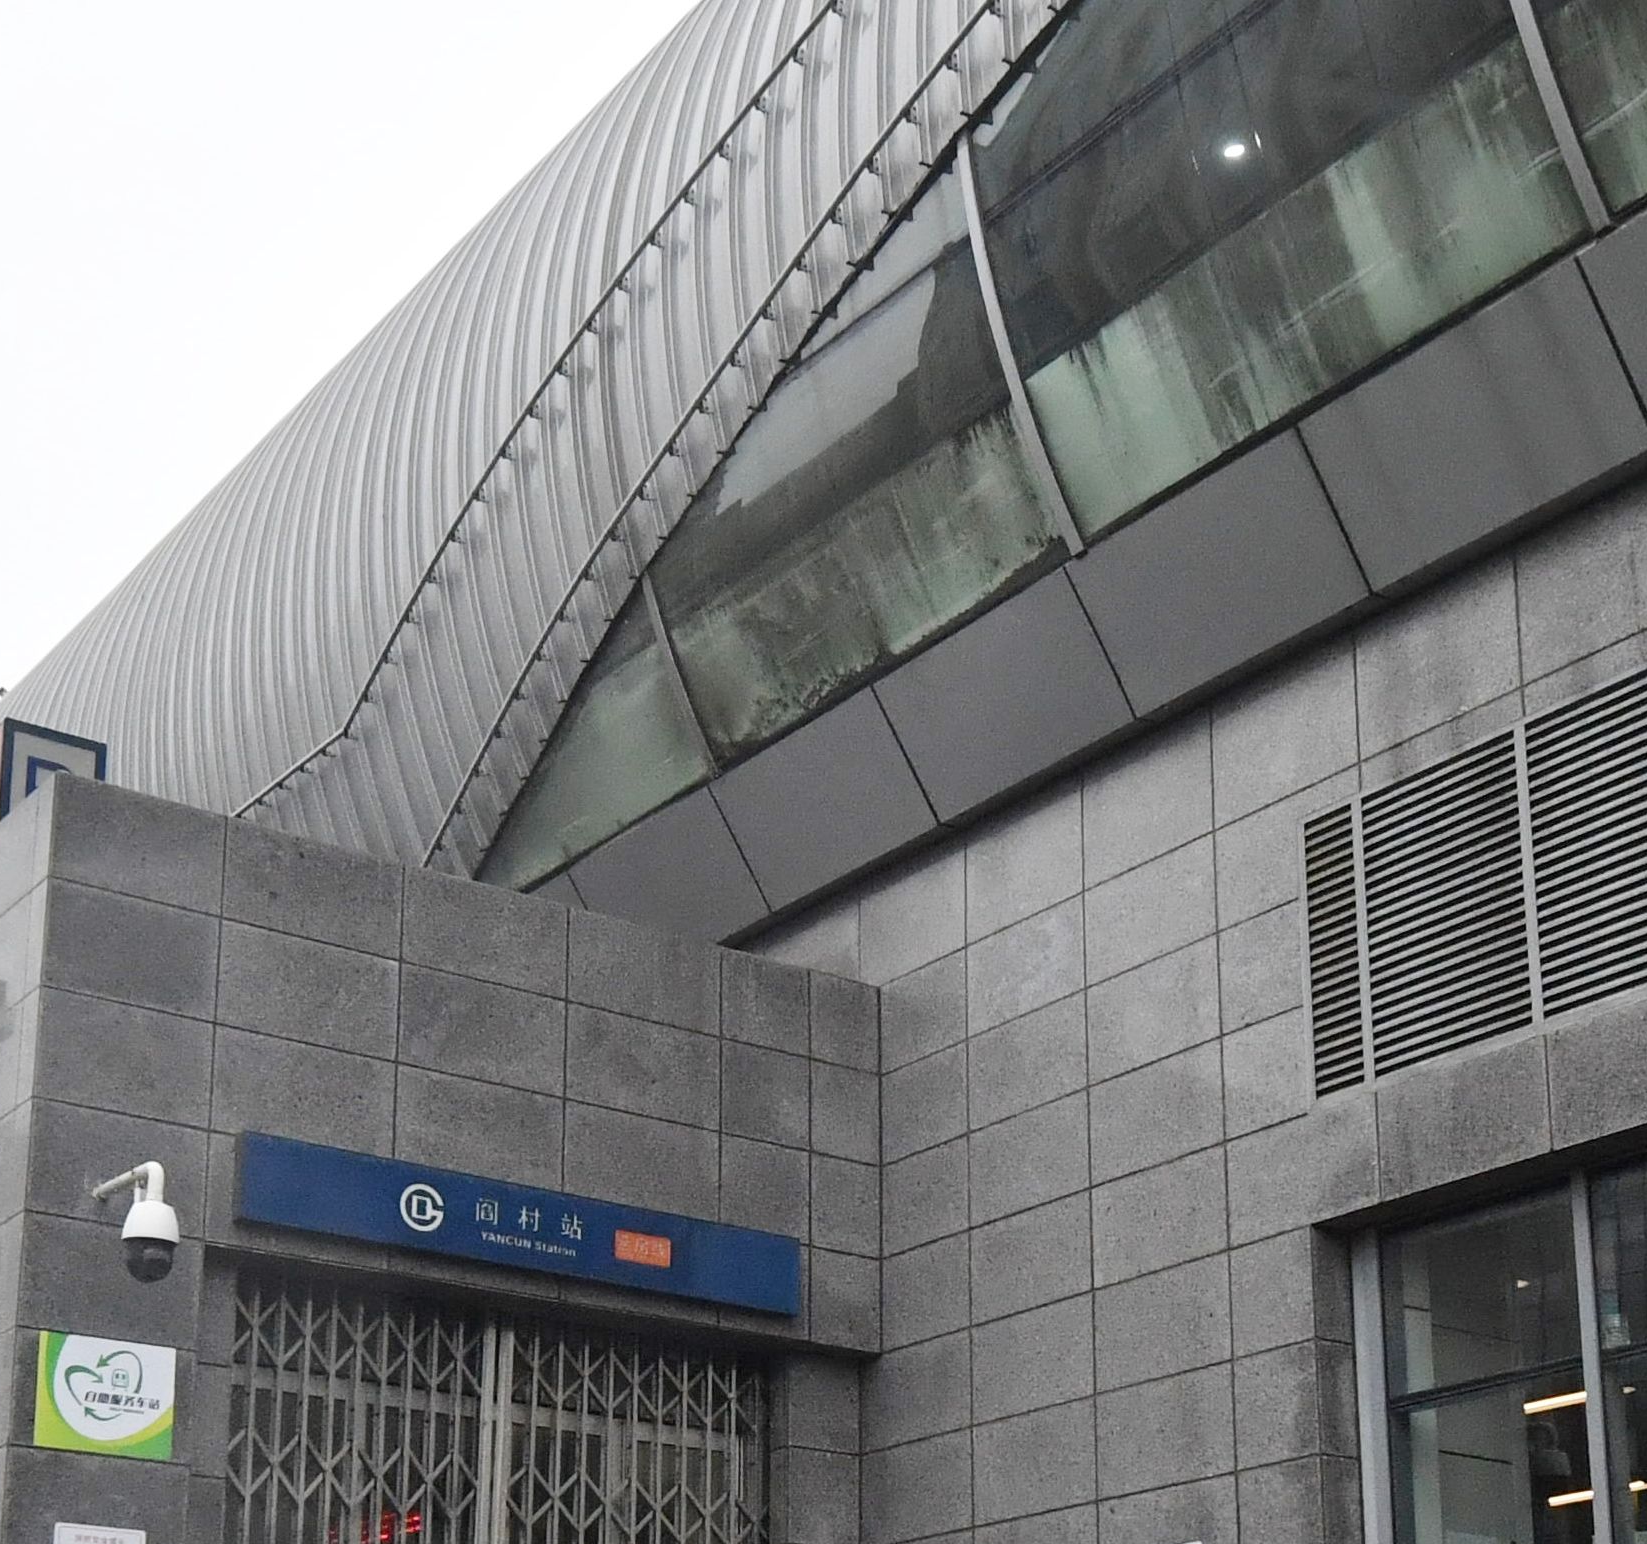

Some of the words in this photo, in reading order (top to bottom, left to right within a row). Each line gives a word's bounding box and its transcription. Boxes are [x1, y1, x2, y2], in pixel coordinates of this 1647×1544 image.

[476, 1197, 583, 1240] 阎村站
[480, 1230, 531, 1249] YANCUN
[534, 1238, 576, 1257] Station
